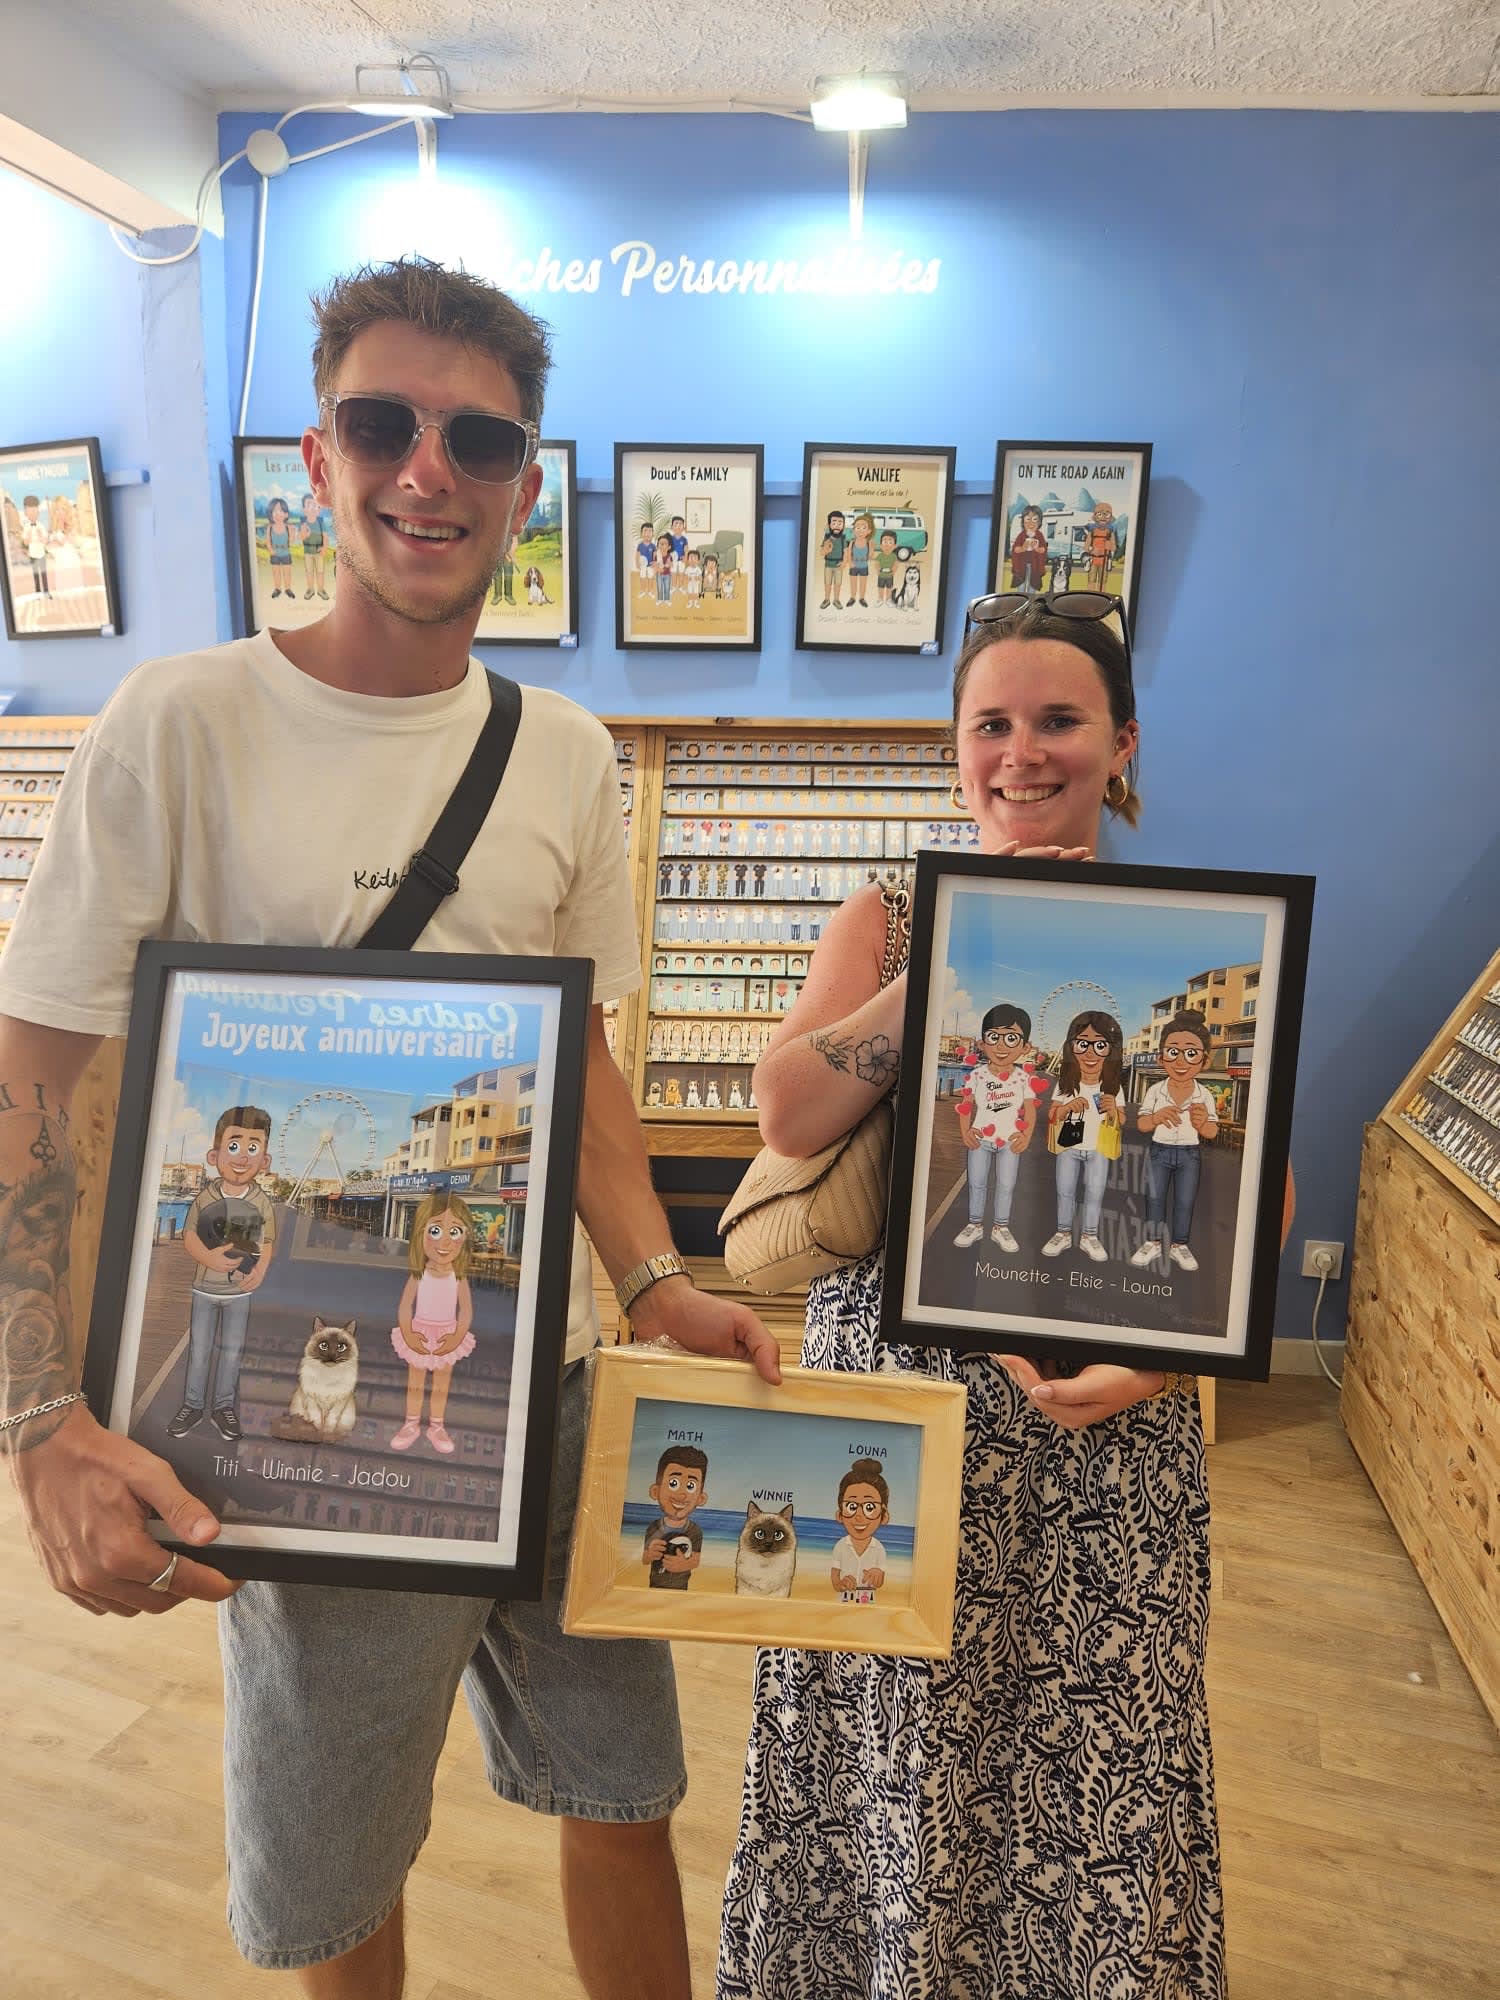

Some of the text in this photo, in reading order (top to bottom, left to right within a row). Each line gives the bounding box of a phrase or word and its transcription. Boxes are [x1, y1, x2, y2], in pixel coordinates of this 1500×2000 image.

[650, 465, 729, 481] Doud's FAMILY
[857, 467, 901, 483] VANLIFE
[1018, 464, 1125, 480] ON THE ROAD AGAIN
[201, 1011, 517, 1061] Joyeux anniversaire!
[450, 1174, 471, 1185] DENIM
[975, 1261, 1051, 1285] Mounette
[1069, 1271, 1103, 1290] Elsie
[1122, 1276, 1173, 1298] Louna
[667, 1428, 703, 1443] MATH
[848, 1443, 888, 1459] LOUNA
[212, 1455, 239, 1478] Titi
[262, 1458, 324, 1483] Winnie
[347, 1463, 411, 1489] Jadou
[752, 1489, 794, 1504] WINNIE
